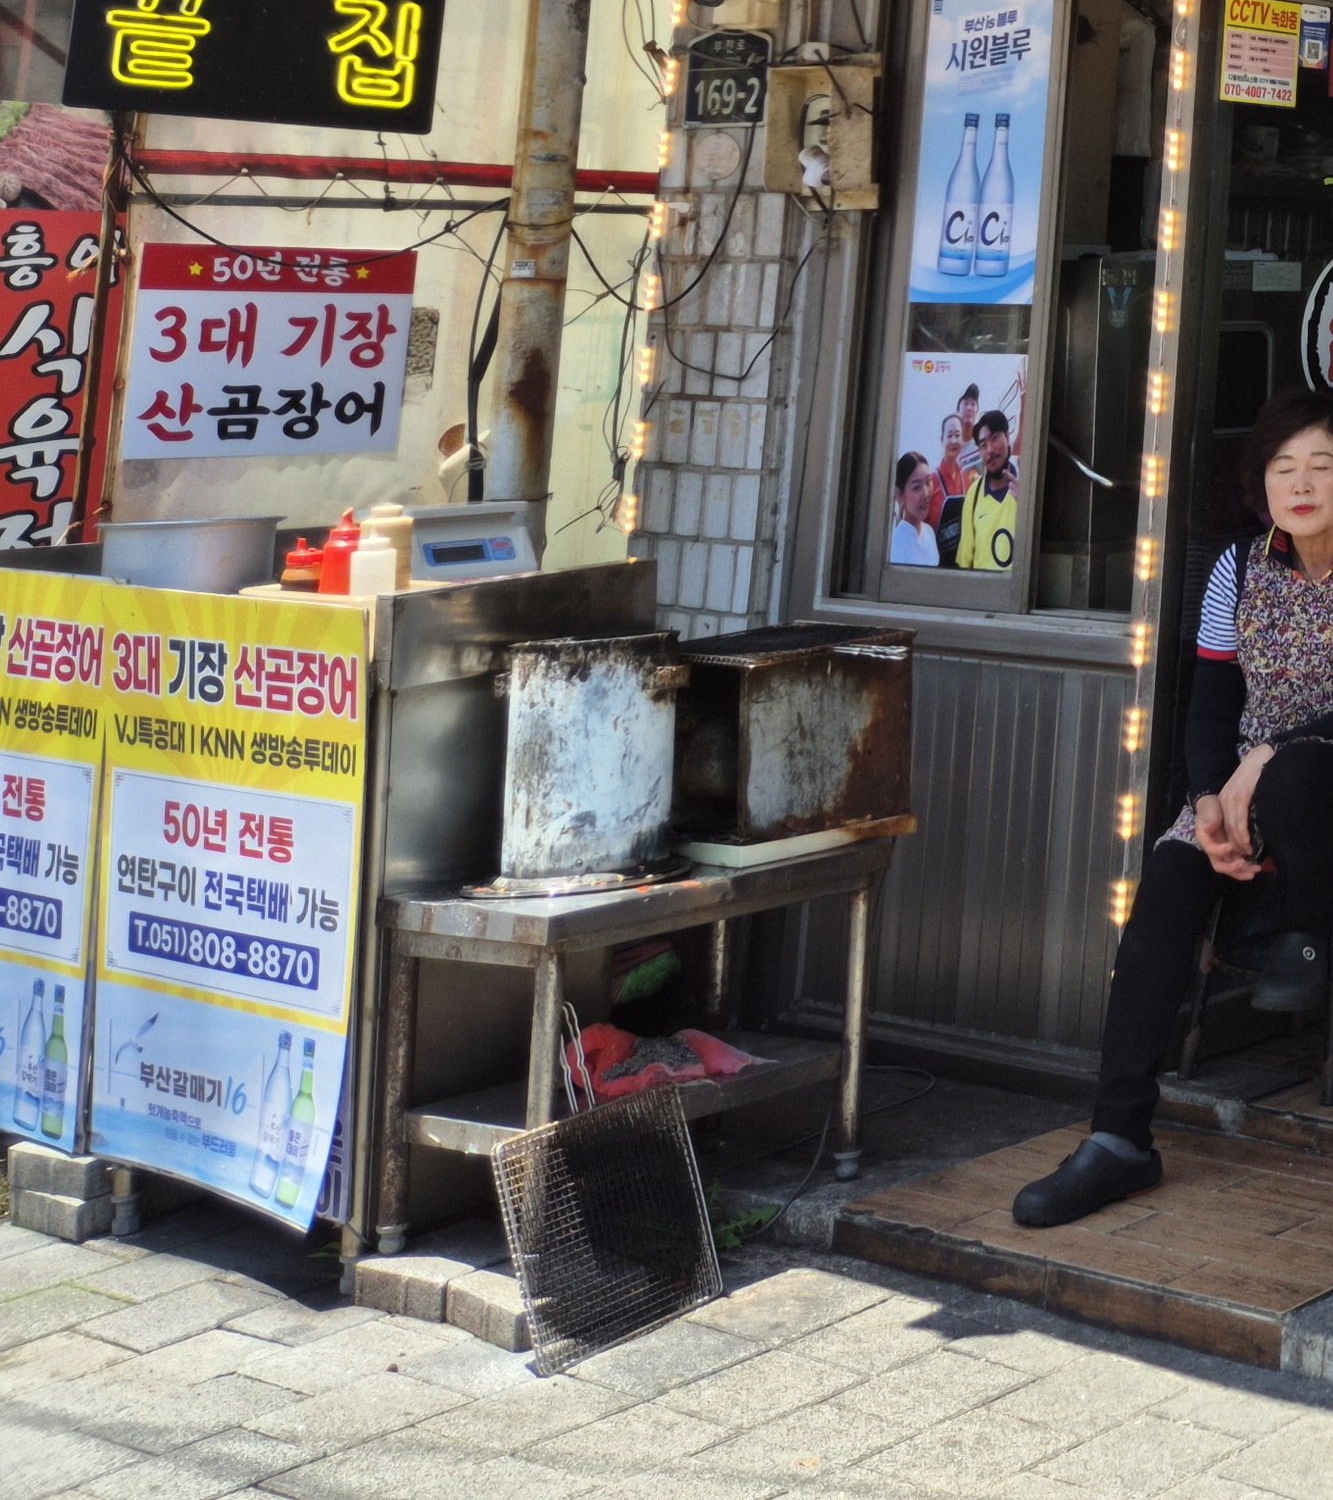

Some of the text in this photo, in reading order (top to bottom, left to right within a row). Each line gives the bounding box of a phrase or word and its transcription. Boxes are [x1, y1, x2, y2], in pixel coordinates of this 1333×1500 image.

[964, 16, 985, 33] 부산
[986, 15, 995, 29] is
[1271, 9, 1298, 30] 녹화중
[945, 28, 1032, 72] 시원블루
[694, 77, 761, 116] 169-2
[1224, 83, 1293, 102] 070-4007-7422
[213, 251, 351, 287] 50년 전통
[149, 301, 398, 369] 3대 기장
[7, 617, 105, 687] 산곰장어
[113, 631, 358, 721] 3대 기장 산곰장어
[14, 699, 98, 740] 생방송투데이
[114, 713, 186, 754] VJ특공대
[200, 725, 246, 761] KNN
[250, 731, 357, 777] 생방송투데이
[2, 773, 46, 822] 전통
[163, 800, 294, 864] 50년 전통
[45, 842, 80, 885] 가능
[117, 853, 340, 932] 연탄구이 전국택배 가능
[139, 1061, 248, 1116] 부산갈매기 16
